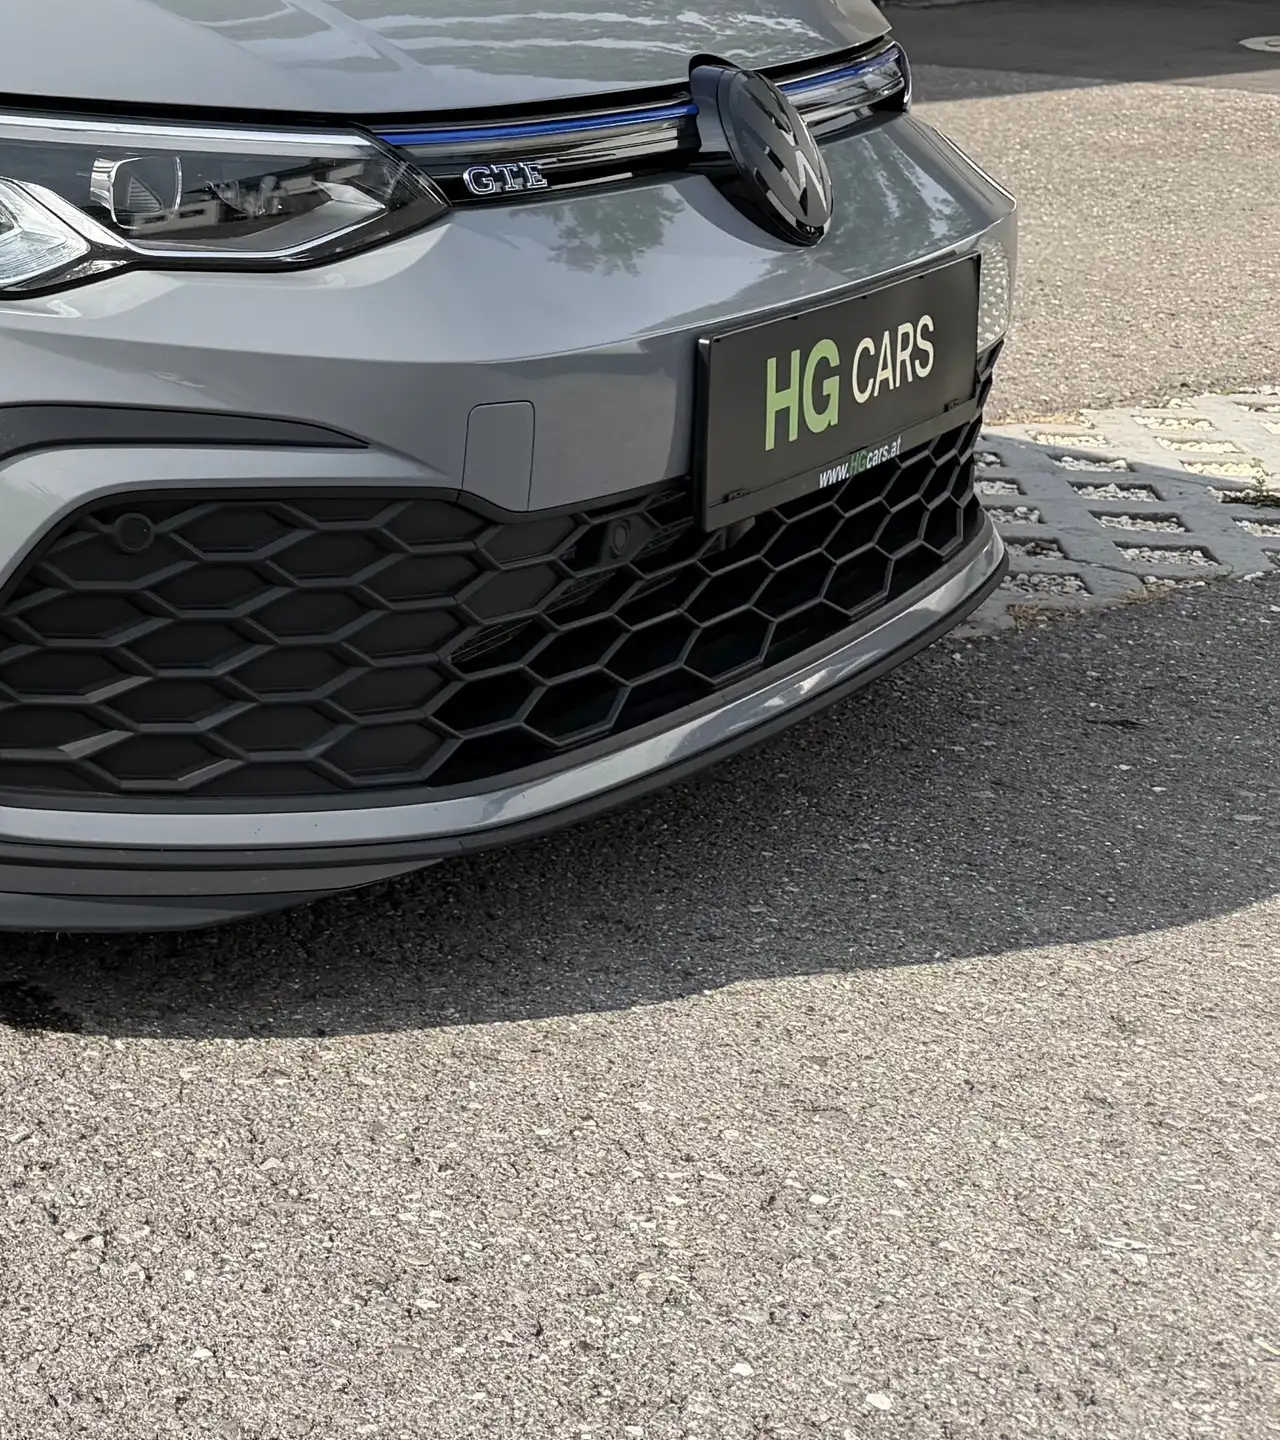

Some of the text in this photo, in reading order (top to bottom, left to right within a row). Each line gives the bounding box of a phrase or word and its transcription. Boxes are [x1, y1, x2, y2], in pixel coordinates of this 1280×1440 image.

[463, 160, 548, 195] GTE
[765, 314, 934, 452] HG CARS
